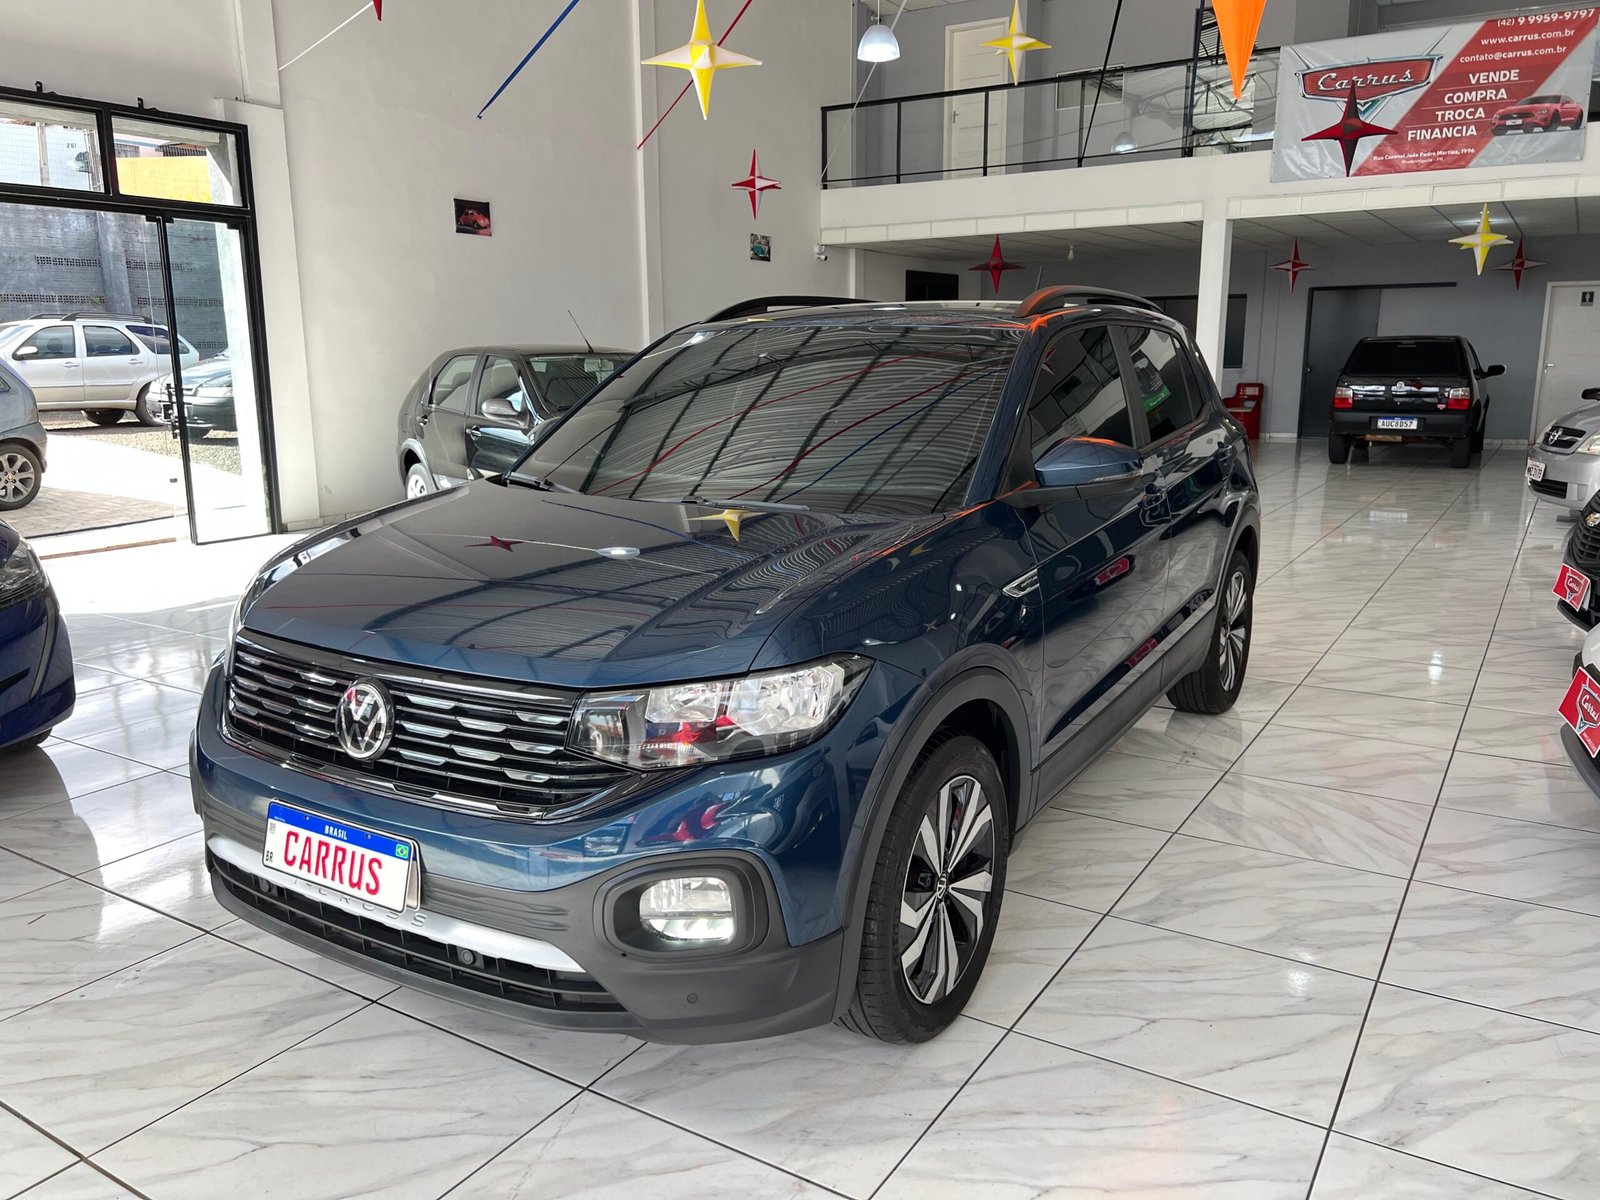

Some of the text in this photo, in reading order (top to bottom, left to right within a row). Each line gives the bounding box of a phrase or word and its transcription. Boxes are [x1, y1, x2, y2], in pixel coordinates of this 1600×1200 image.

[1497, 8, 1596, 27] (42) 9 9959-9797
[1480, 28, 1576, 46] www.carrus.com.br
[1459, 45, 1567, 63] contato@carrus.com.br
[1317, 69, 1415, 91] Carrus
[1468, 69, 1520, 85] VENDE
[1444, 88, 1507, 105] COMPRA
[1435, 107, 1486, 122] TROCA
[1407, 125, 1477, 141] FINANCIA
[324, 824, 348, 841] BRASIL
[265, 850, 274, 863] BR
[283, 830, 383, 896] CARRUS
